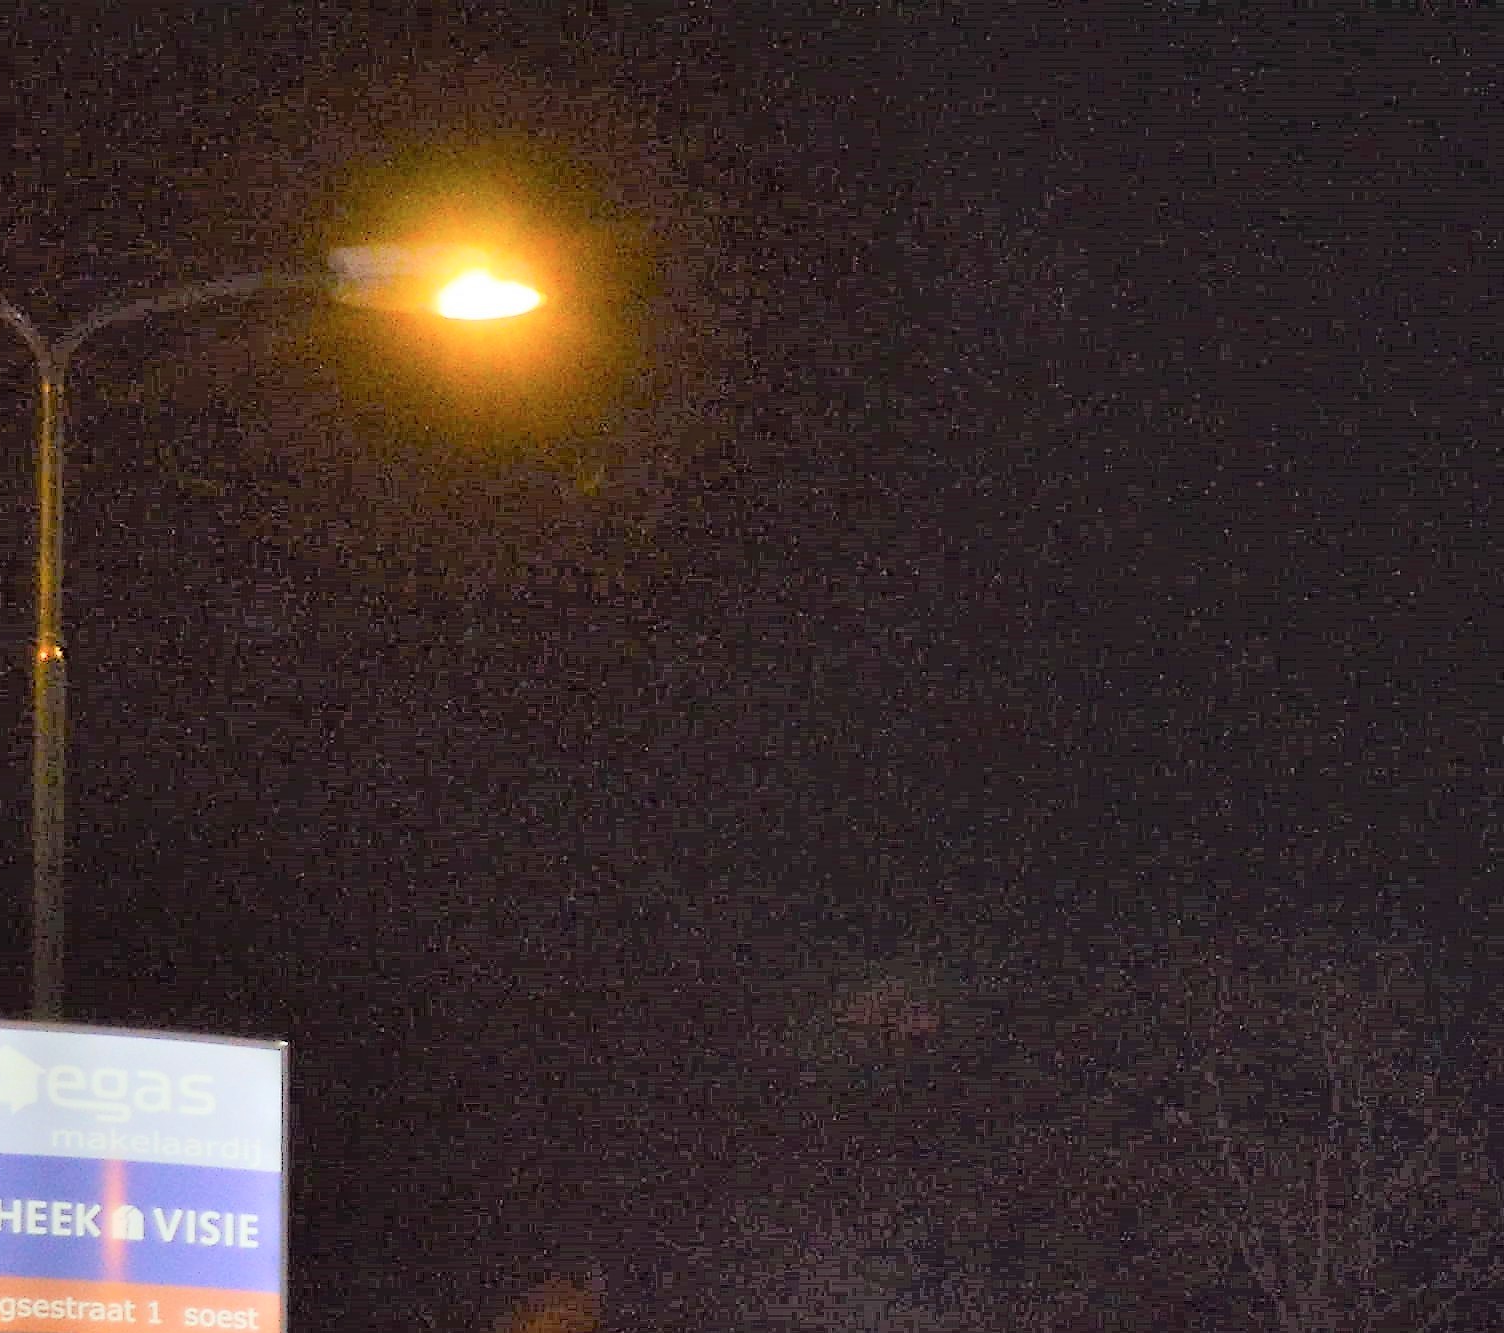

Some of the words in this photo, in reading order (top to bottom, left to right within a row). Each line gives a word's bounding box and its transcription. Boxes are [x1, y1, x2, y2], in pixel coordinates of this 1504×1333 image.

[46, 1061, 217, 1122] egas
[51, 1127, 264, 1166] makelaardij
[153, 1206, 261, 1249] VISIE
[148, 1301, 164, 1325] 1
[184, 1304, 260, 1331] soest
